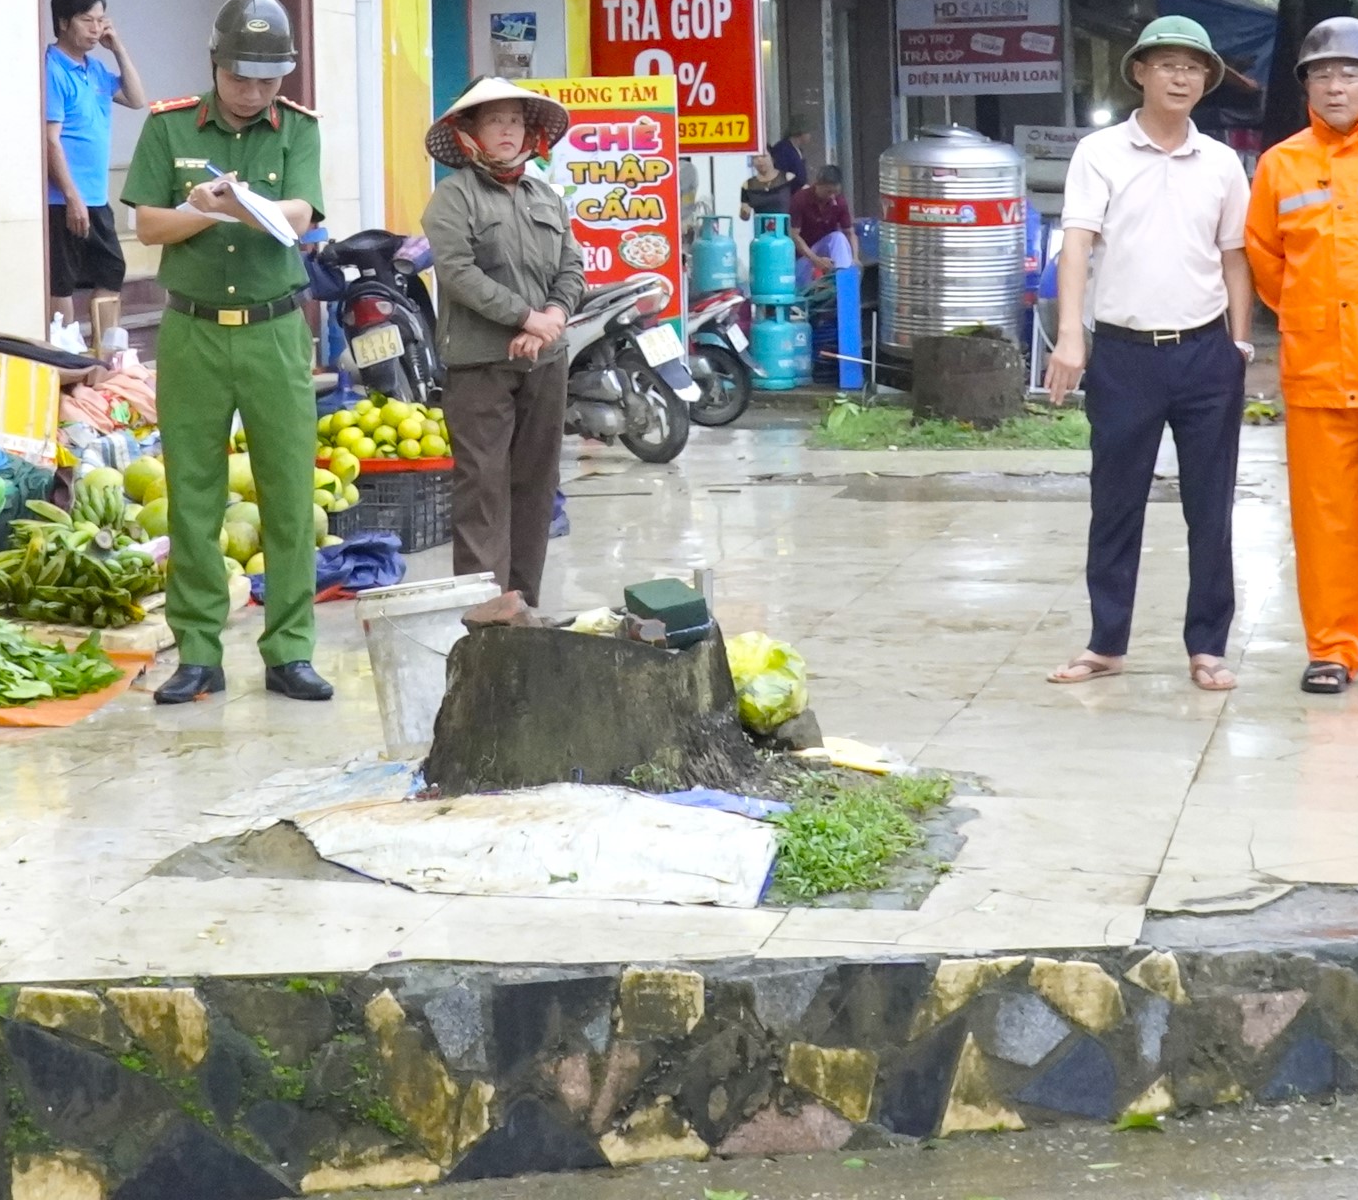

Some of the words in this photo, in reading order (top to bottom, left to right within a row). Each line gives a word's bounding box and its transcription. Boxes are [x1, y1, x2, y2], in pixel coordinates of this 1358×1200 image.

[1023, 70, 1059, 82] LOAN
[559, 81, 612, 104] HỒNG
[619, 85, 658, 102] TÂM
[569, 119, 660, 151] CHÈ
[567, 154, 670, 188] THẬP
[576, 187, 664, 221] CẨM
[583, 241, 612, 272] ÈO
